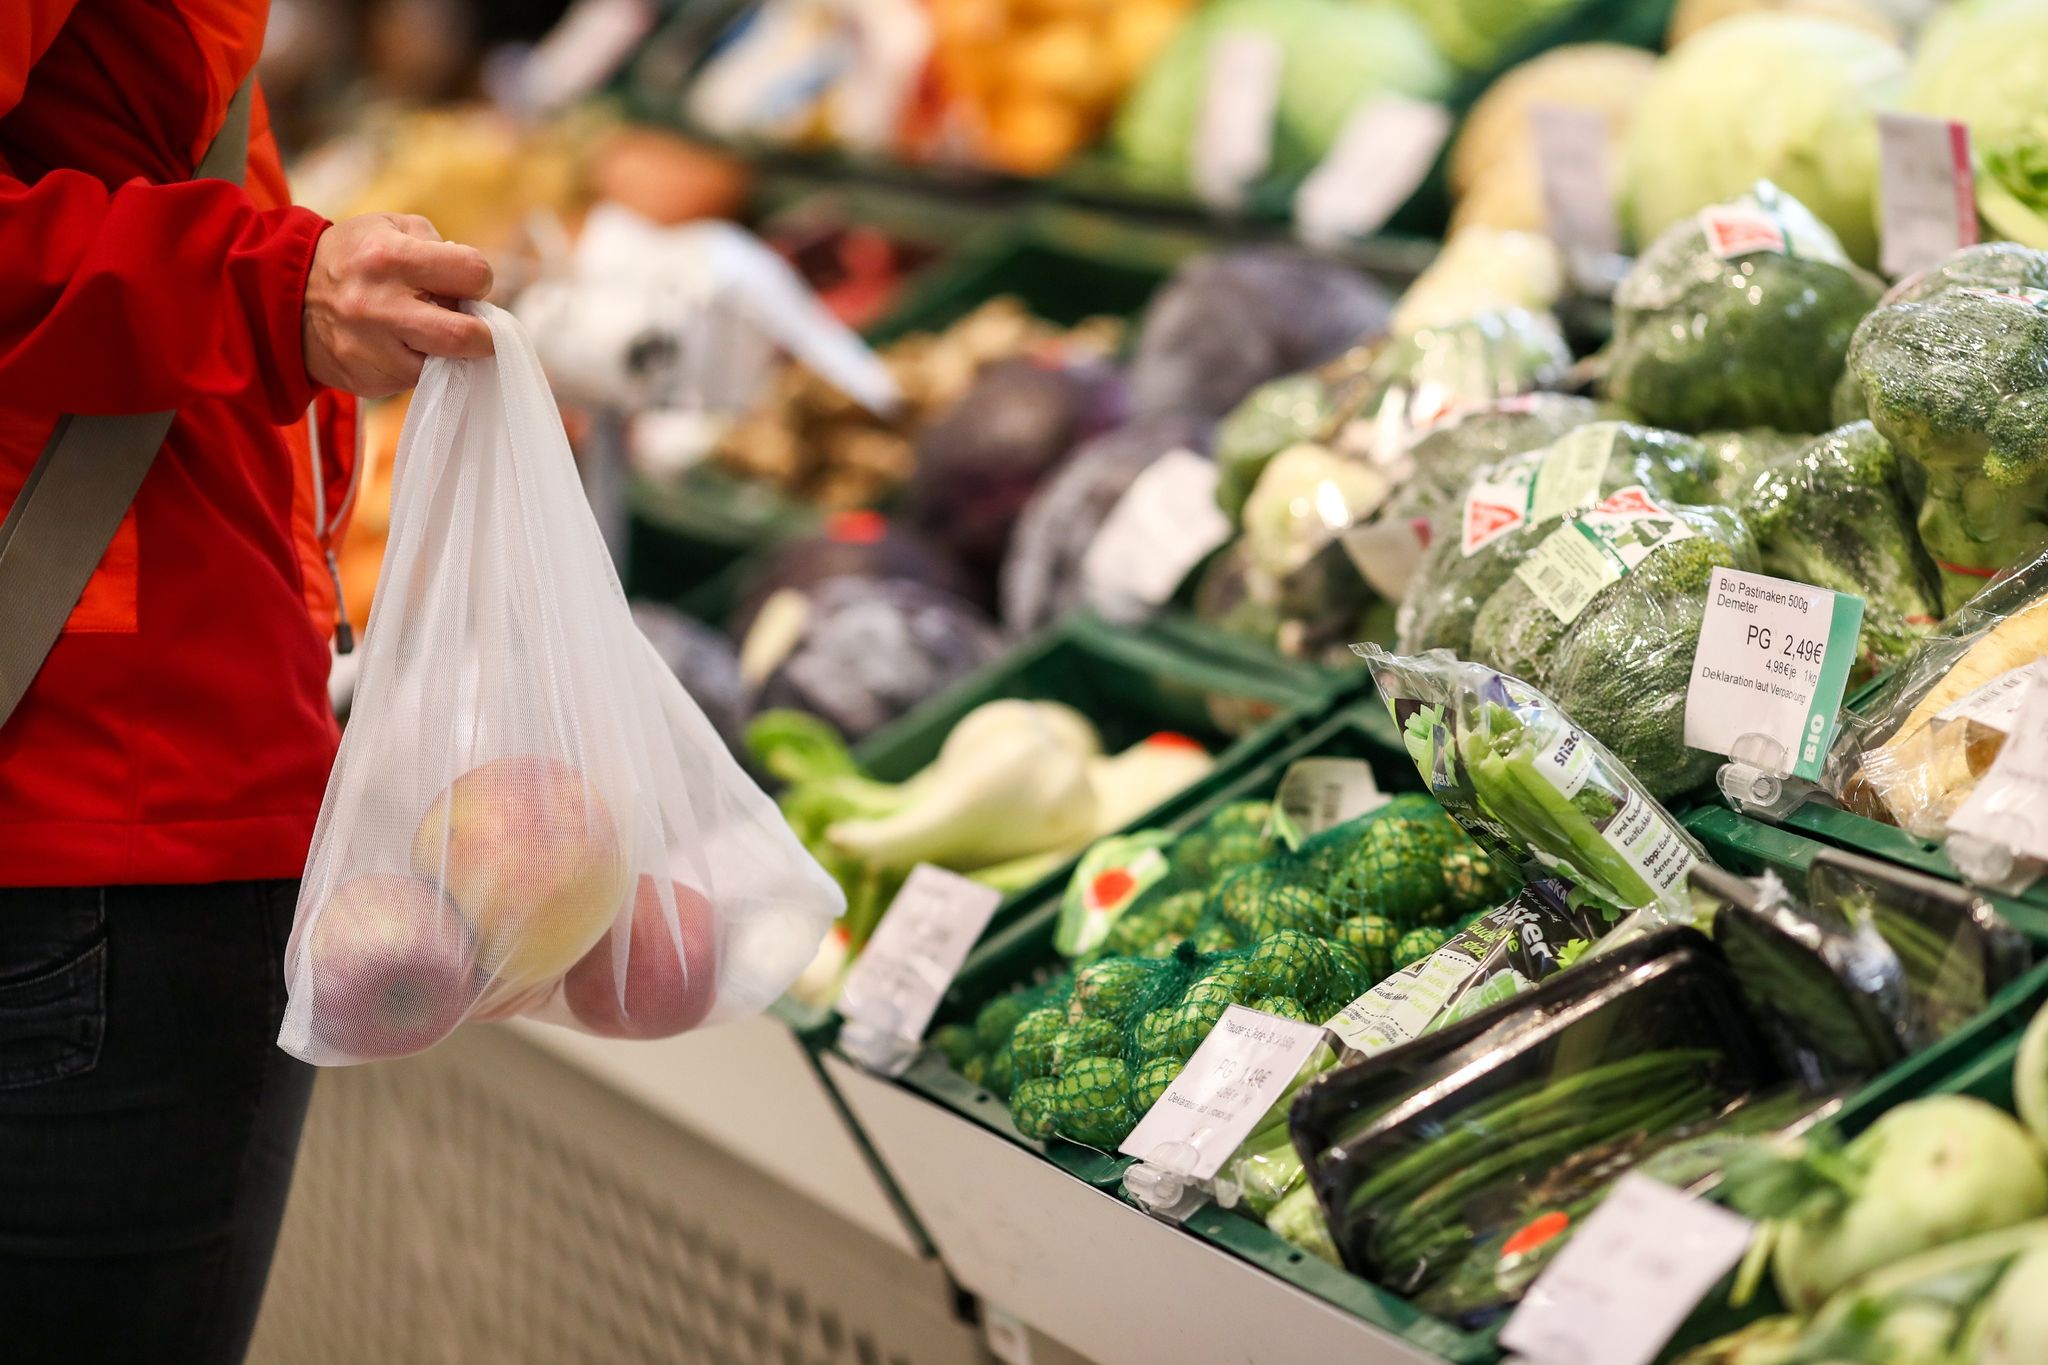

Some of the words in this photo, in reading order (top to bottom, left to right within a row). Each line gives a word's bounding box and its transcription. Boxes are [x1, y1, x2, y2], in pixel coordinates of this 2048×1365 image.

[1717, 593, 1758, 614] Demeter
[1720, 578, 1736, 593] Bio
[1738, 582, 1786, 606] Pastinaken
[1788, 594, 1808, 614] 500g
[1746, 624, 1771, 649] PG
[1783, 634, 1824, 664] 2,49€
[1702, 666, 1754, 689] Deklaration
[1755, 679, 1769, 693] laut
[1803, 714, 1825, 763] BIO
